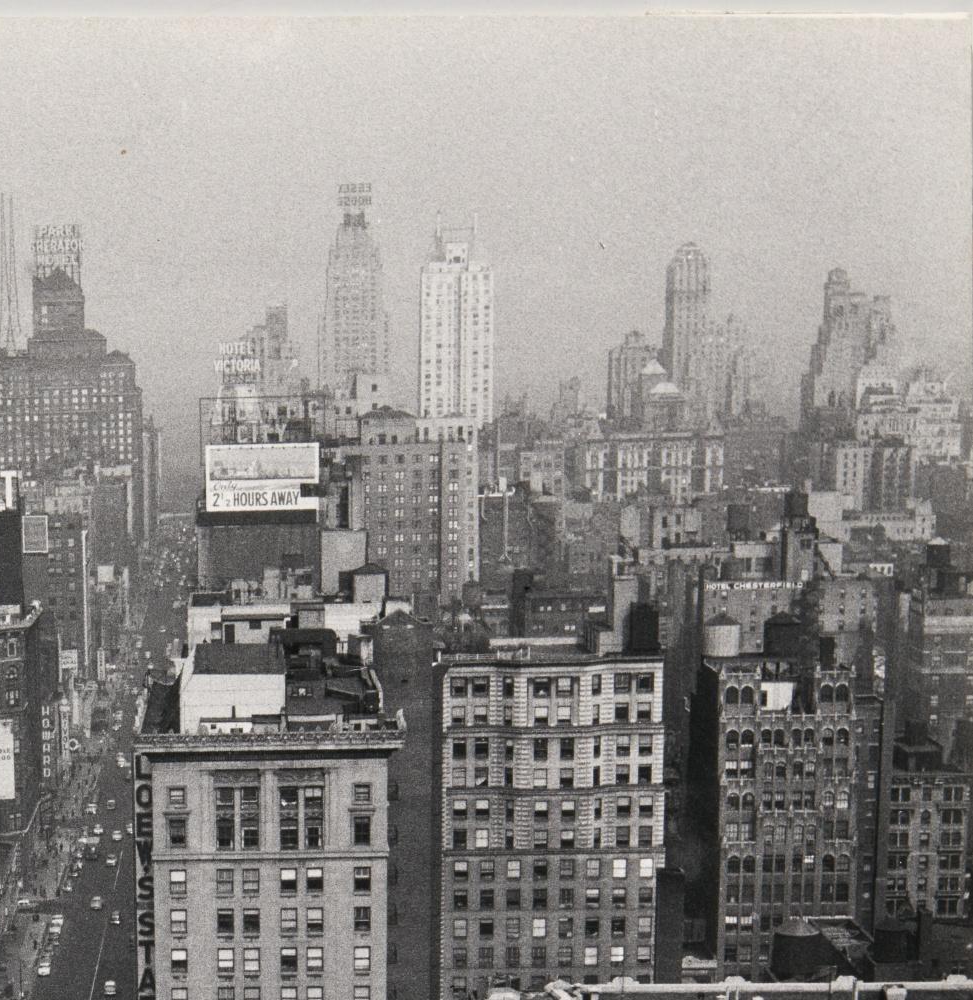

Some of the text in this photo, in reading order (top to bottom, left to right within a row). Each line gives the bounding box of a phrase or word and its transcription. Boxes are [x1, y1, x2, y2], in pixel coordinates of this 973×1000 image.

[218, 341, 254, 355] HOTEL
[214, 359, 261, 372] VICTORIA
[233, 491, 269, 507] HOURS
[270, 490, 301, 506] AWAY
[733, 581, 803, 590] CHESTERFIELD
[41, 705, 52, 778] HOWARD
